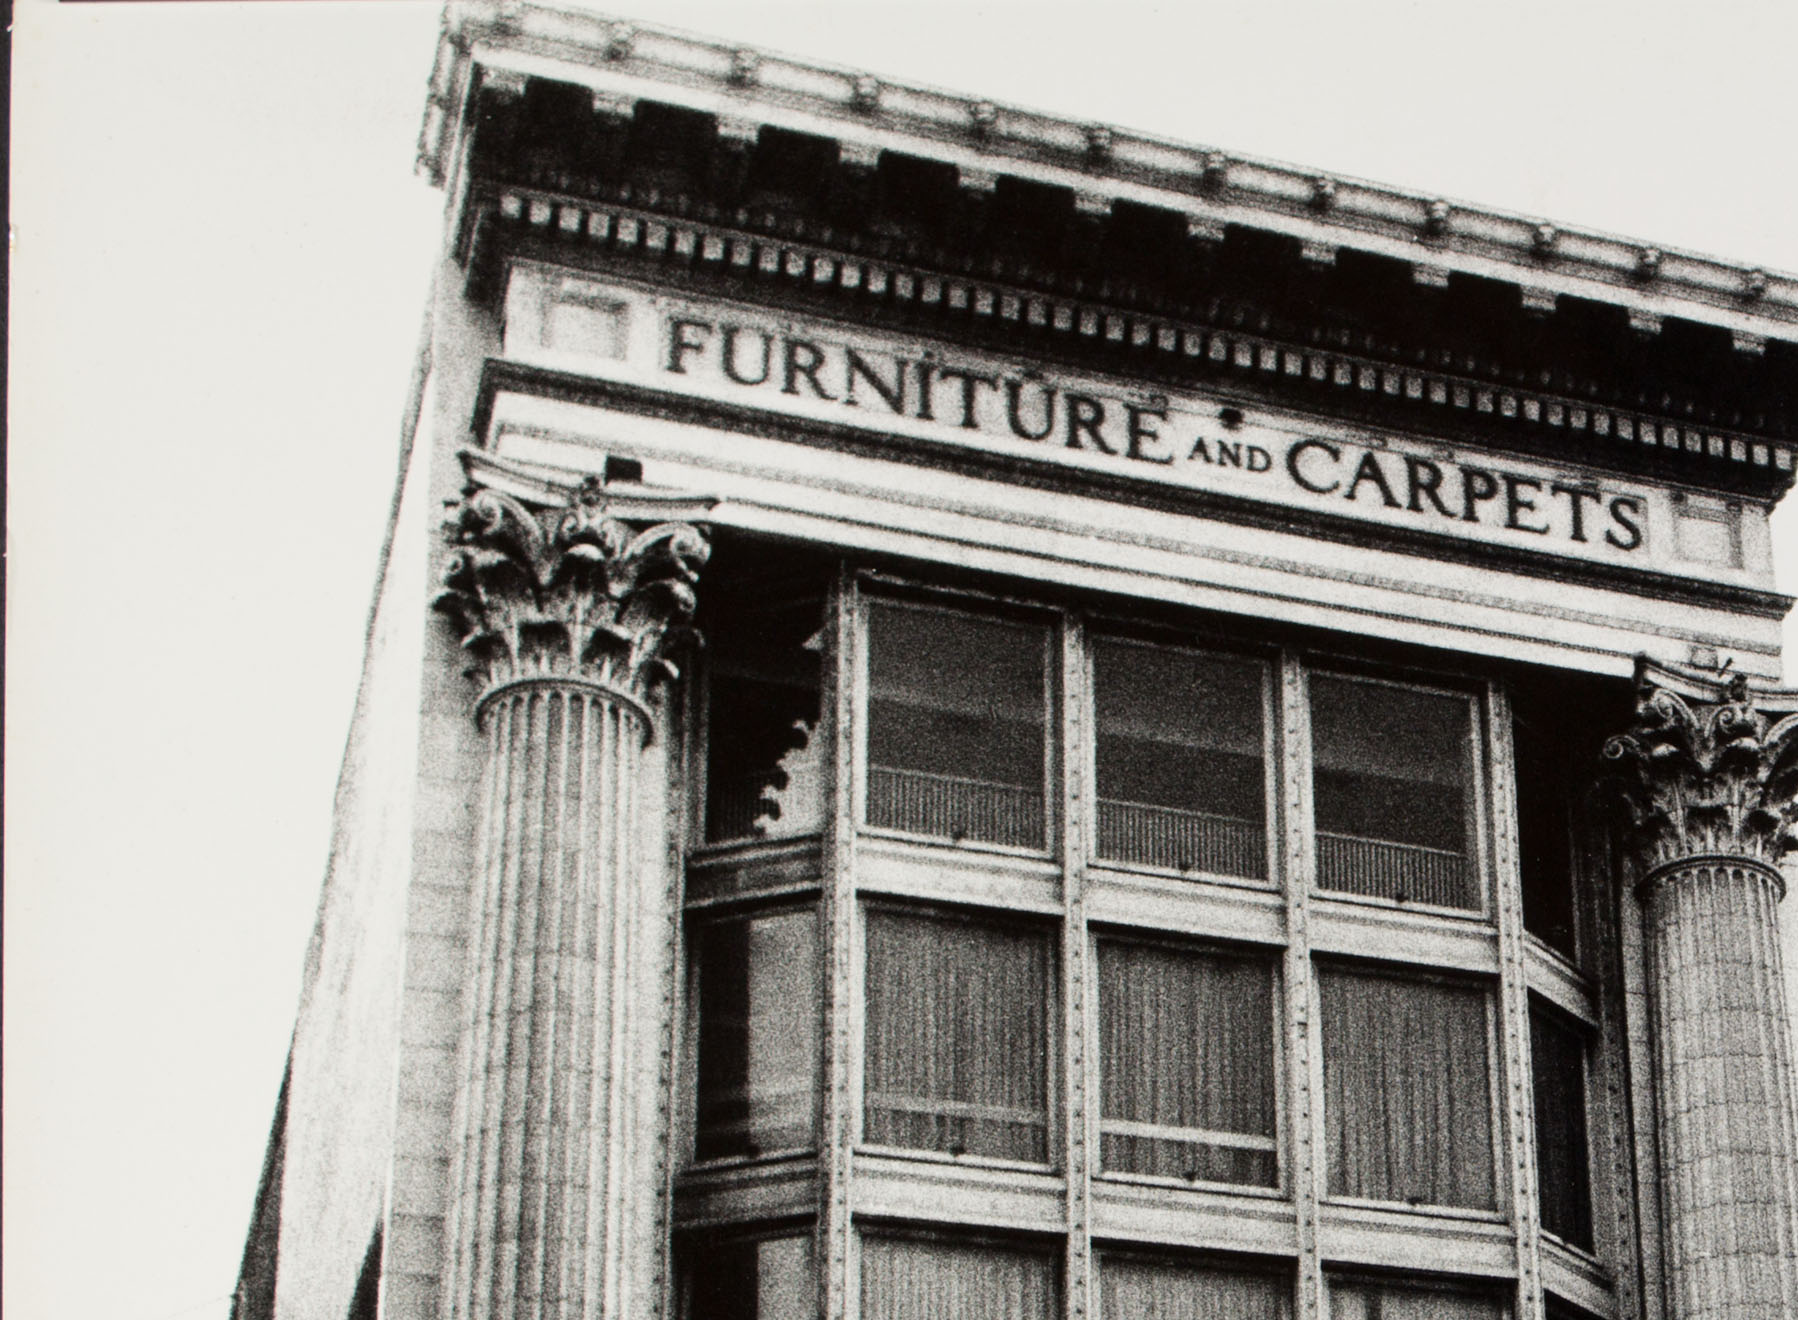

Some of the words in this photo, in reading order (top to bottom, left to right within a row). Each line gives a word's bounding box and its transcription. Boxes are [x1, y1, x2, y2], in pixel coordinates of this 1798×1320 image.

[665, 317, 1175, 465] FURNITURE
[1187, 437, 1272, 474] AND
[1285, 437, 1648, 551] CARPETS
